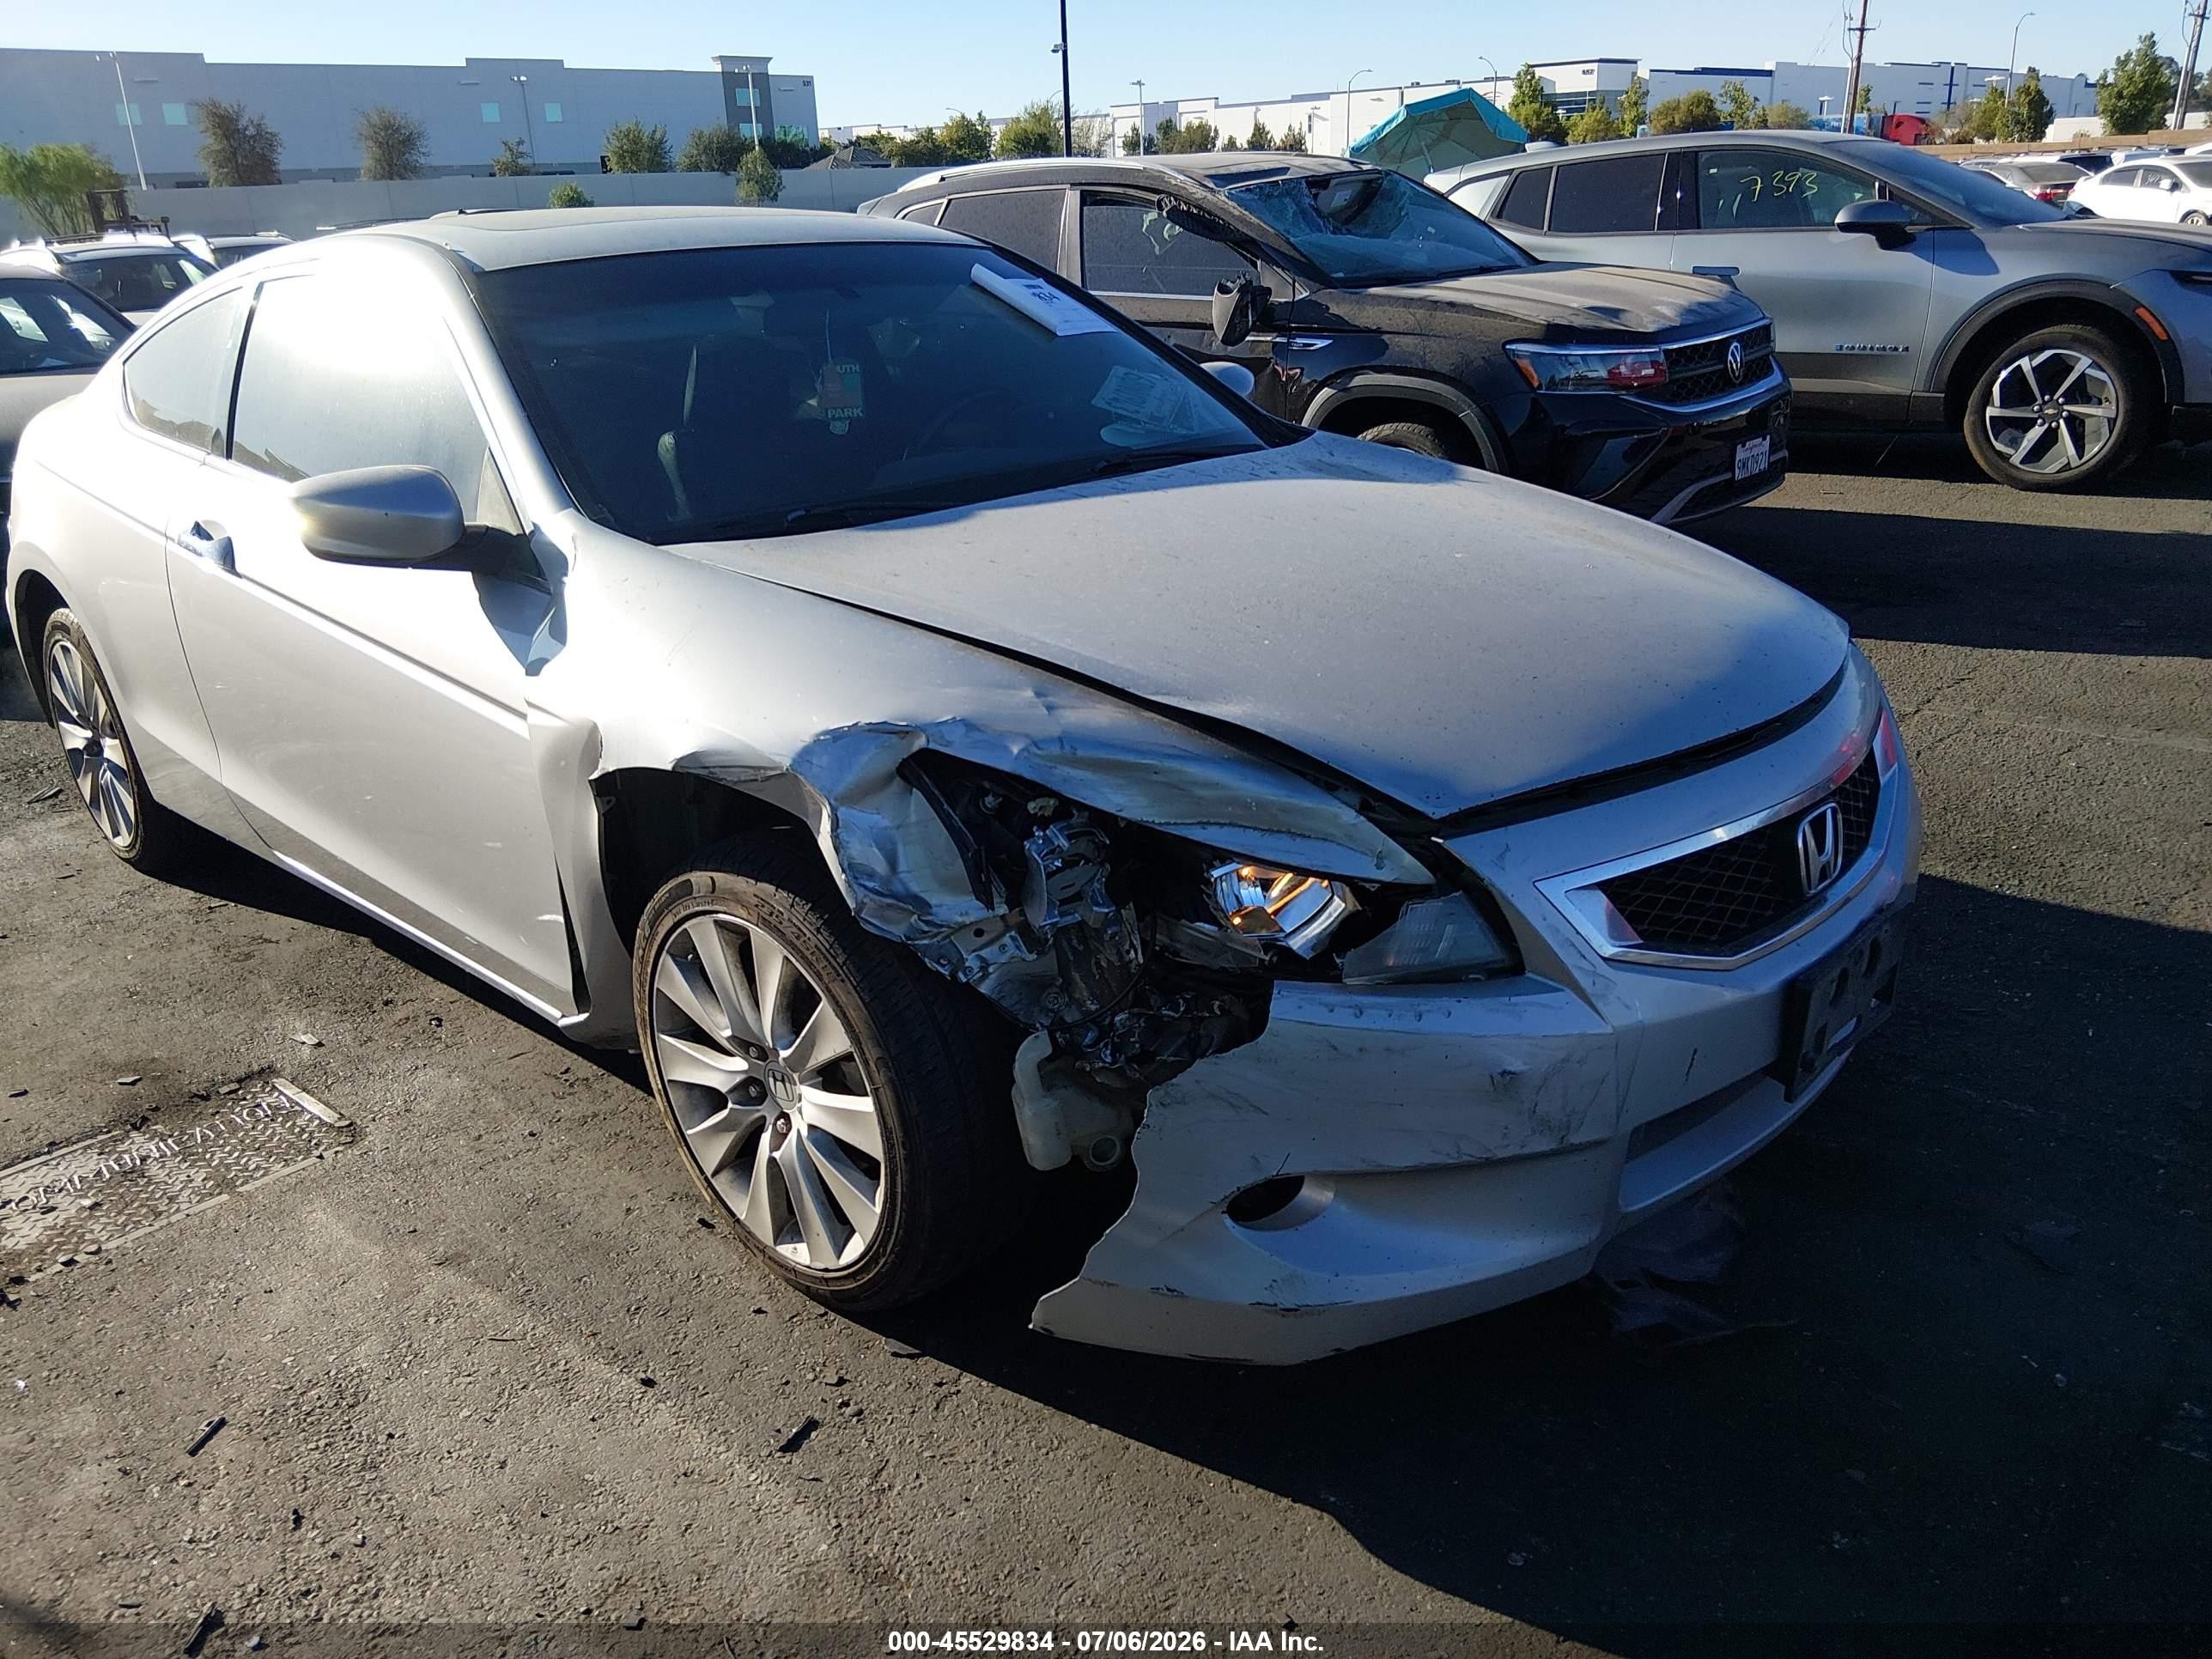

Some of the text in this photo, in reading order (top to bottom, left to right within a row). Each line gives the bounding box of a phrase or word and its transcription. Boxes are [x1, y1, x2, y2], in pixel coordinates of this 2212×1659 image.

[1739, 170, 1819, 202] 7393
[827, 406, 864, 418] PARK
[1736, 451, 1767, 480] 9MKD921
[11, 1095, 290, 1210] OMMUNICATION
